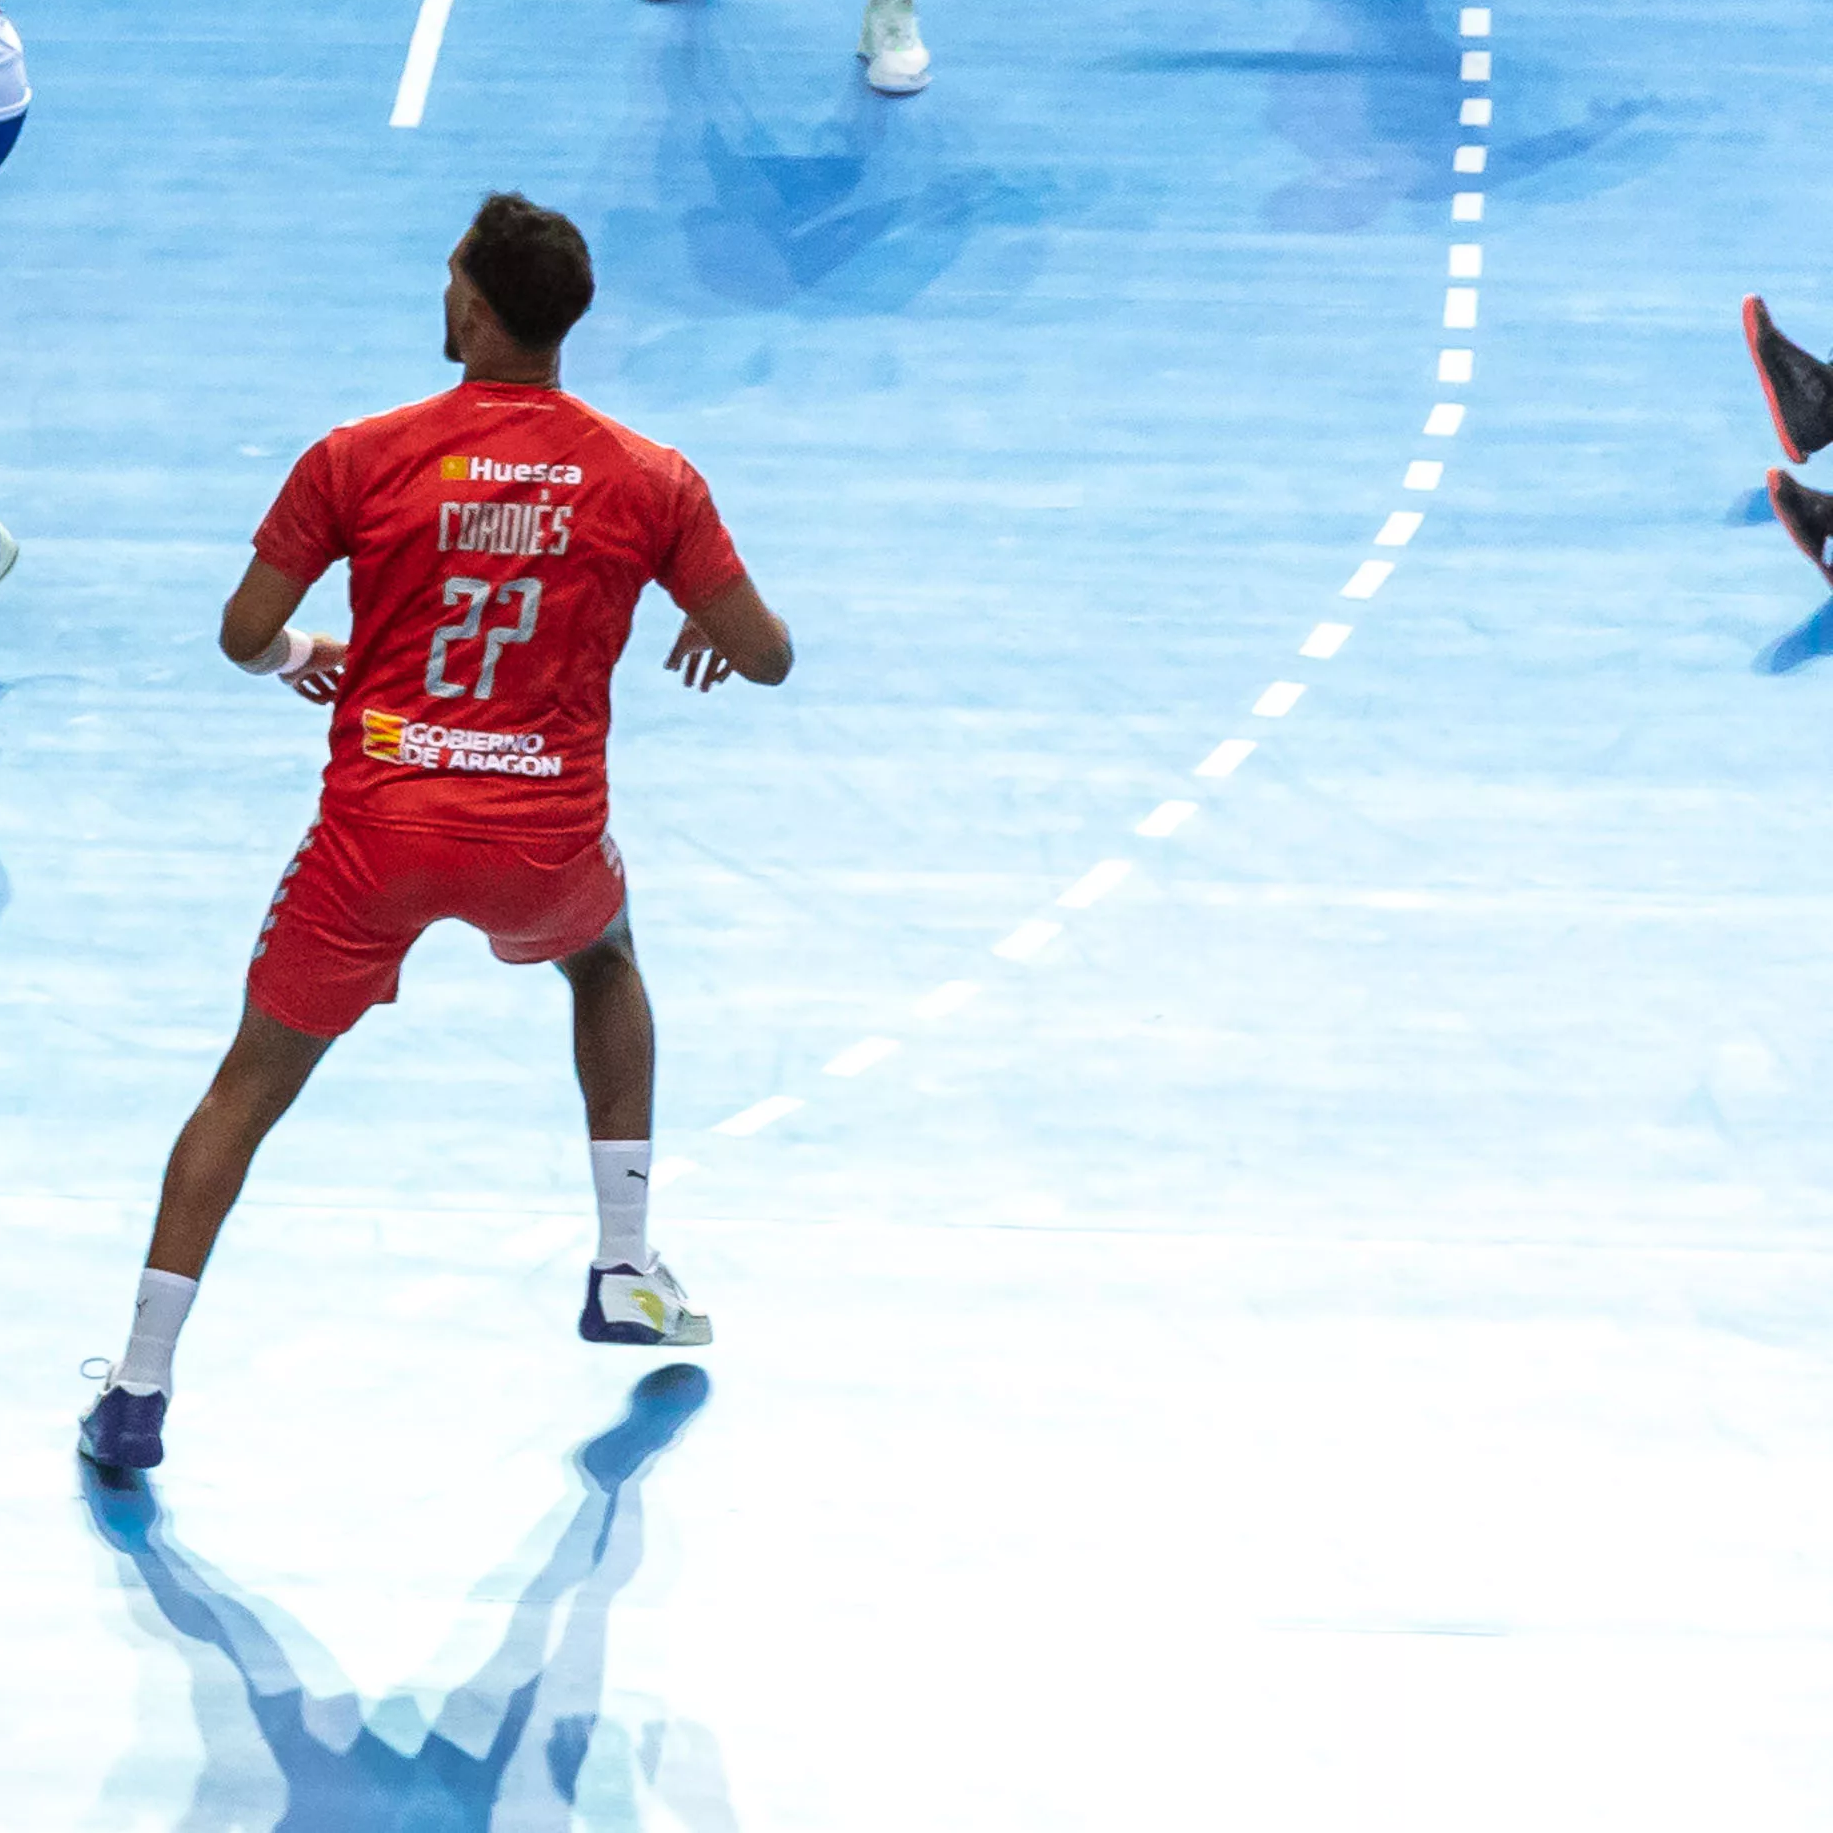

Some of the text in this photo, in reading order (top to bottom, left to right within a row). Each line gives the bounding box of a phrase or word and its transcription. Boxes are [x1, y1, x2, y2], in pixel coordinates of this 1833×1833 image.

[469, 457, 583, 485] Huesca
[406, 721, 545, 754] GOBIERNO
[403, 745, 562, 777] DE ARAGON
